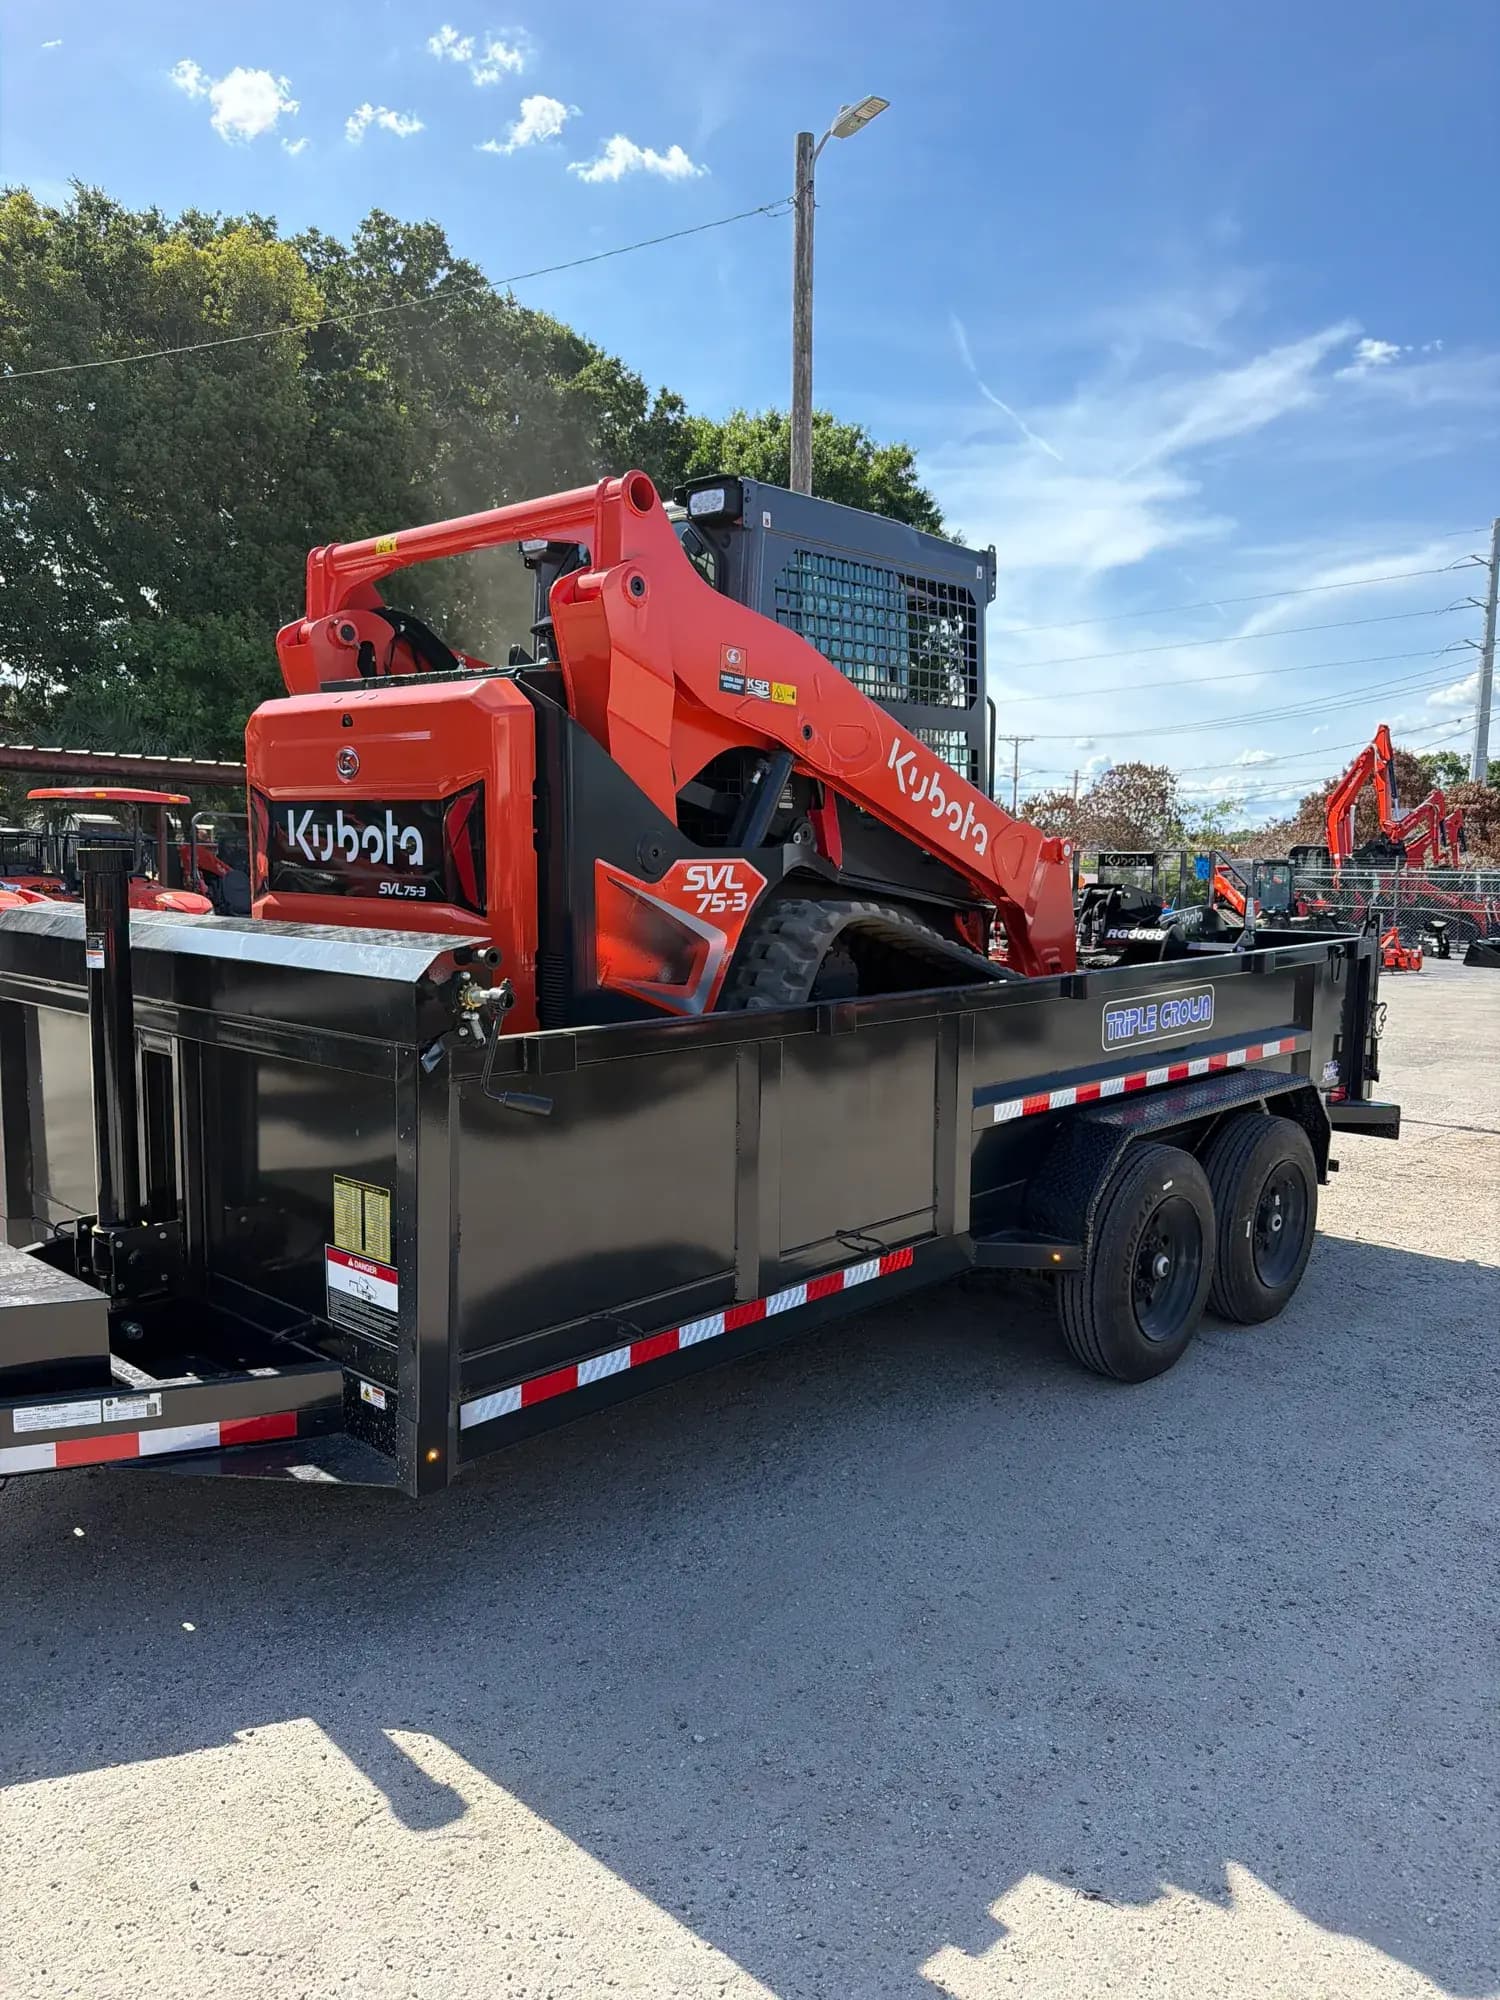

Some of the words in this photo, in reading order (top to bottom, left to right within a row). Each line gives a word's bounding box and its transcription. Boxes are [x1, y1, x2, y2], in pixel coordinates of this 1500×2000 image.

[746, 678, 770, 692] KSR
[888, 738, 988, 856] Kubota
[287, 809, 424, 866] Kubota
[1105, 854, 1148, 866] Kubota
[682, 865, 743, 891] SVL
[696, 892, 748, 914] 75-3
[1106, 1004, 1158, 1041] TRIPLE
[1160, 994, 1212, 1030] CROWN
[354, 1260, 377, 1276] DANGER
